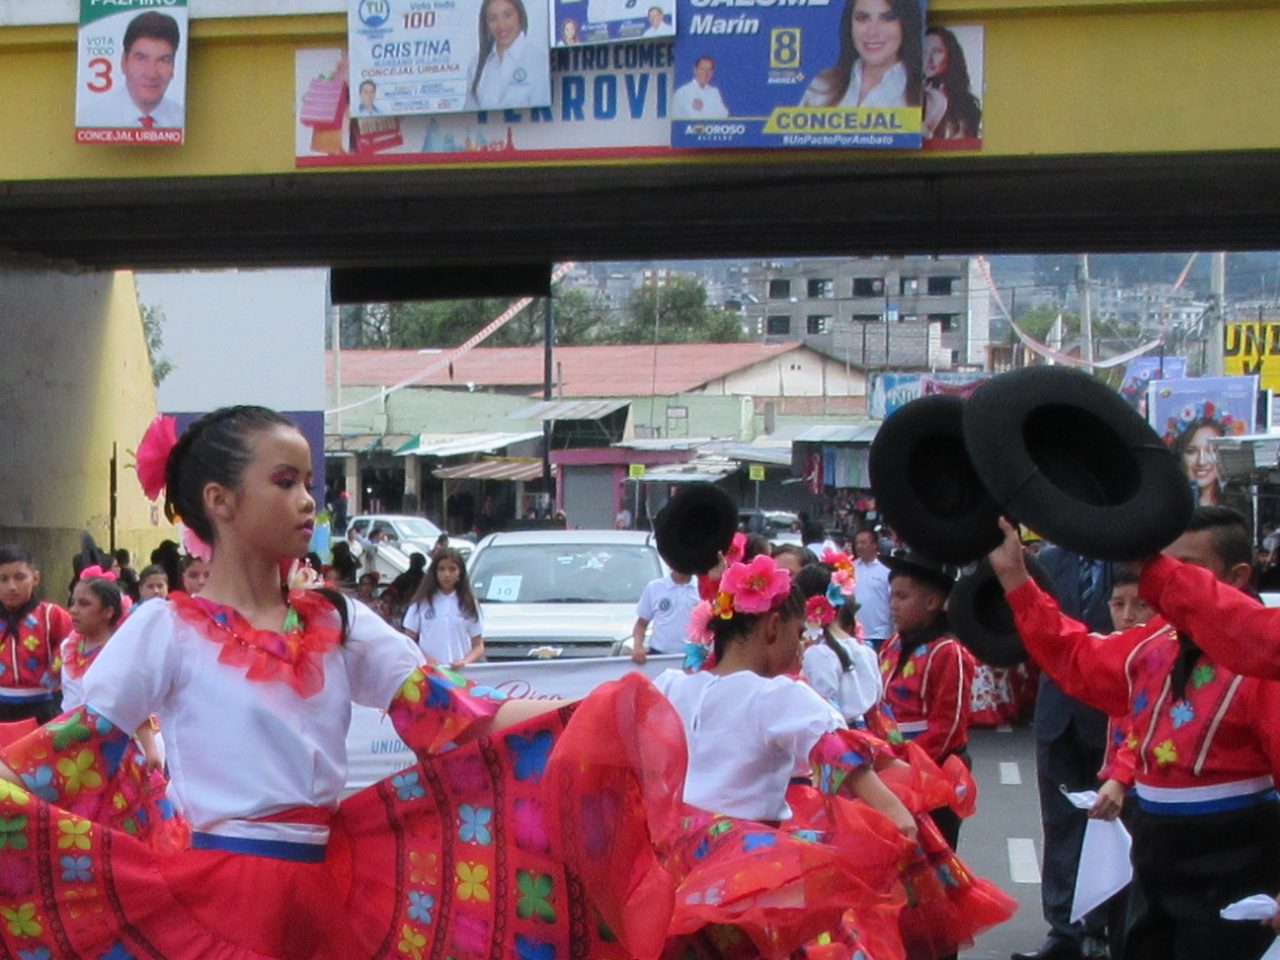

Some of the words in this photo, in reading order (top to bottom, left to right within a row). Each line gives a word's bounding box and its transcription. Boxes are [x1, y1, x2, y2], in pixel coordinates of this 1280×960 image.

[404, 11, 436, 29] 100
[690, 14, 760, 34] Marín
[86, 37, 114, 46] VOTA
[371, 39, 452, 59] CRISTINA
[773, 31, 798, 65] 8
[86, 47, 114, 56] TODO
[86, 57, 113, 93] 3
[360, 66, 413, 78] CONCEJAL
[417, 63, 461, 74] URBANA
[776, 112, 903, 130] CONCEJAL
[77, 130, 134, 142] CONCEJAL
[135, 130, 181, 142] URBANO
[782, 134, 894, 146] #UnPactoPorAmbato
